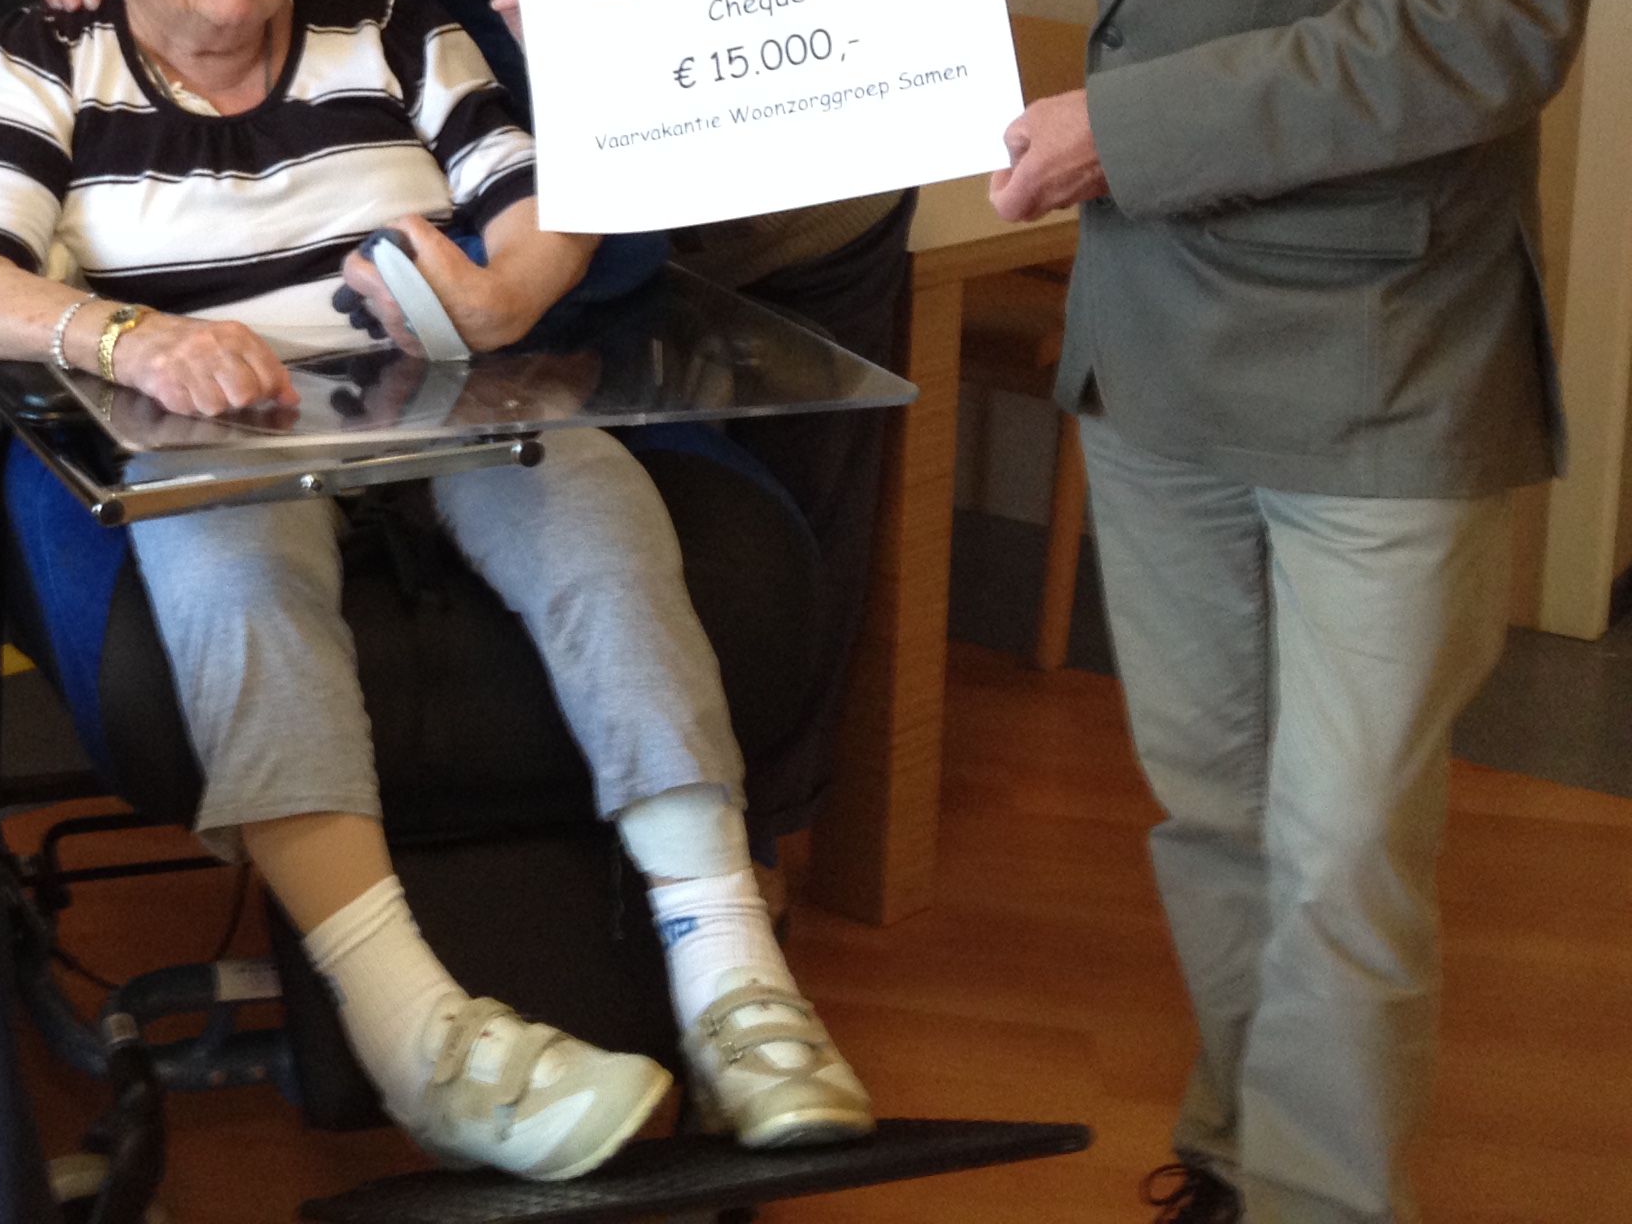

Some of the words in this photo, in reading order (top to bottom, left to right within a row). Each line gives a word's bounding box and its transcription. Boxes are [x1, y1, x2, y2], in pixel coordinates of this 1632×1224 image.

[673, 57, 696, 88] €
[710, 28, 860, 82] 15.000,-
[595, 113, 722, 150] Vaarvakantie
[729, 79, 890, 125] Woonzorggroep
[898, 62, 968, 90] Samen
